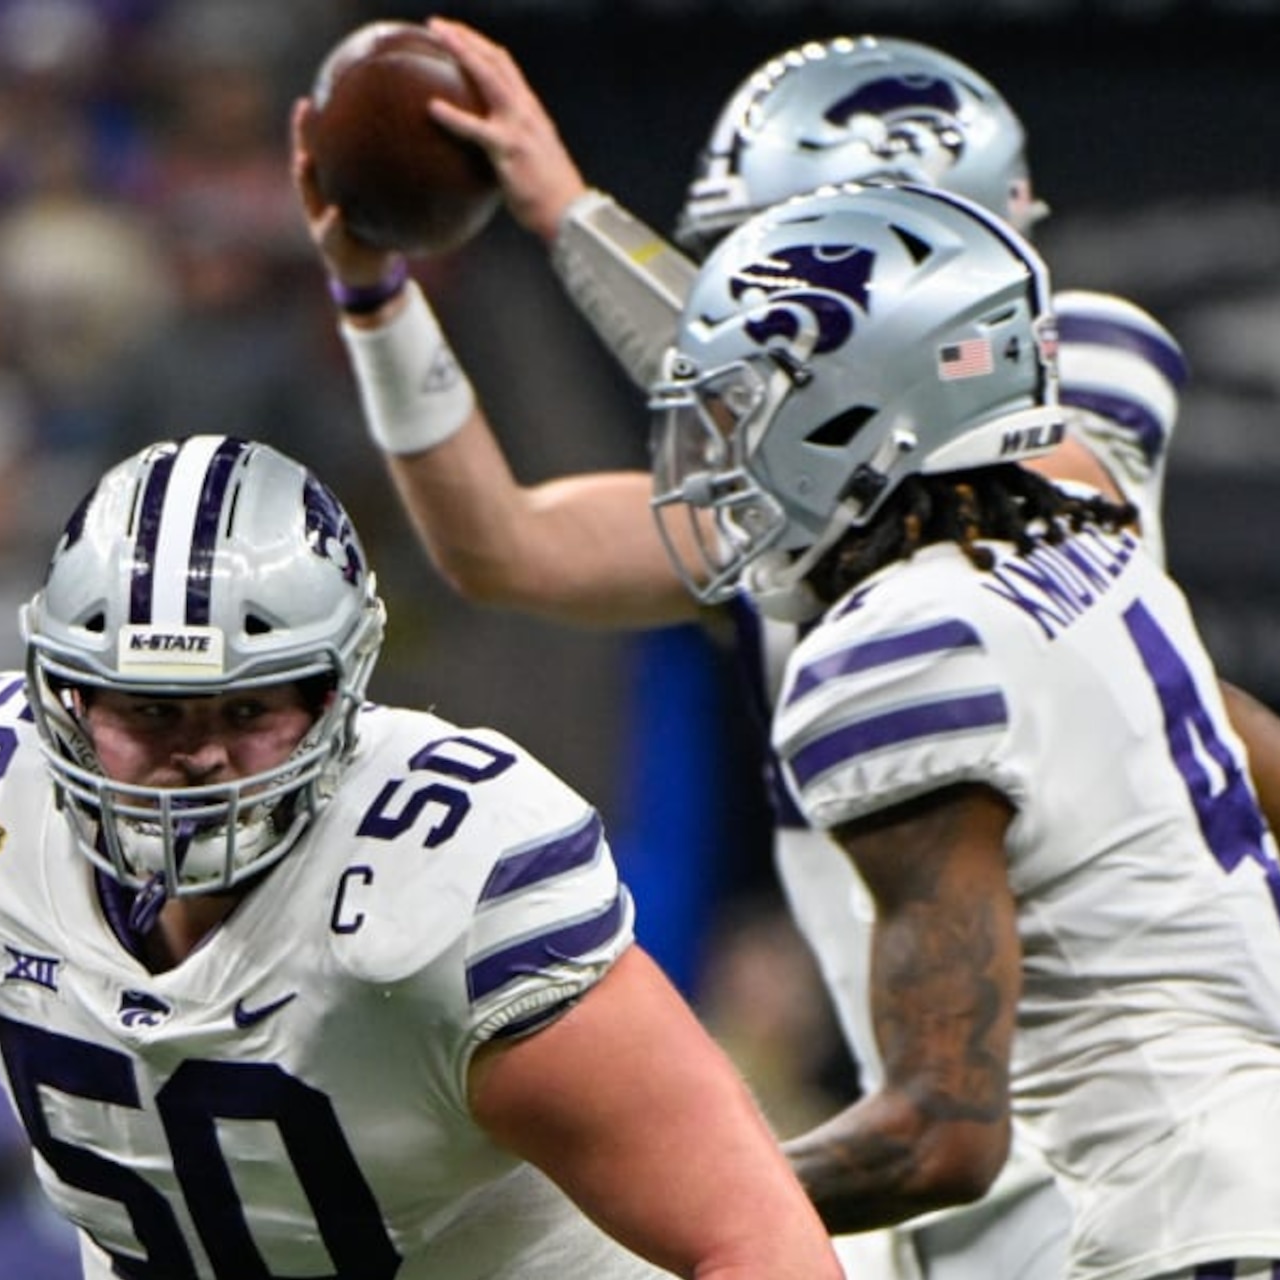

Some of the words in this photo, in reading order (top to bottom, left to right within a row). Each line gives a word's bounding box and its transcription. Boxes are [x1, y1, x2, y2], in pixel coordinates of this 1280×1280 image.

[1004, 336, 1020, 363] 4
[130, 633, 211, 653] K-STATE
[356, 736, 518, 849] 50
[330, 865, 374, 934] C
